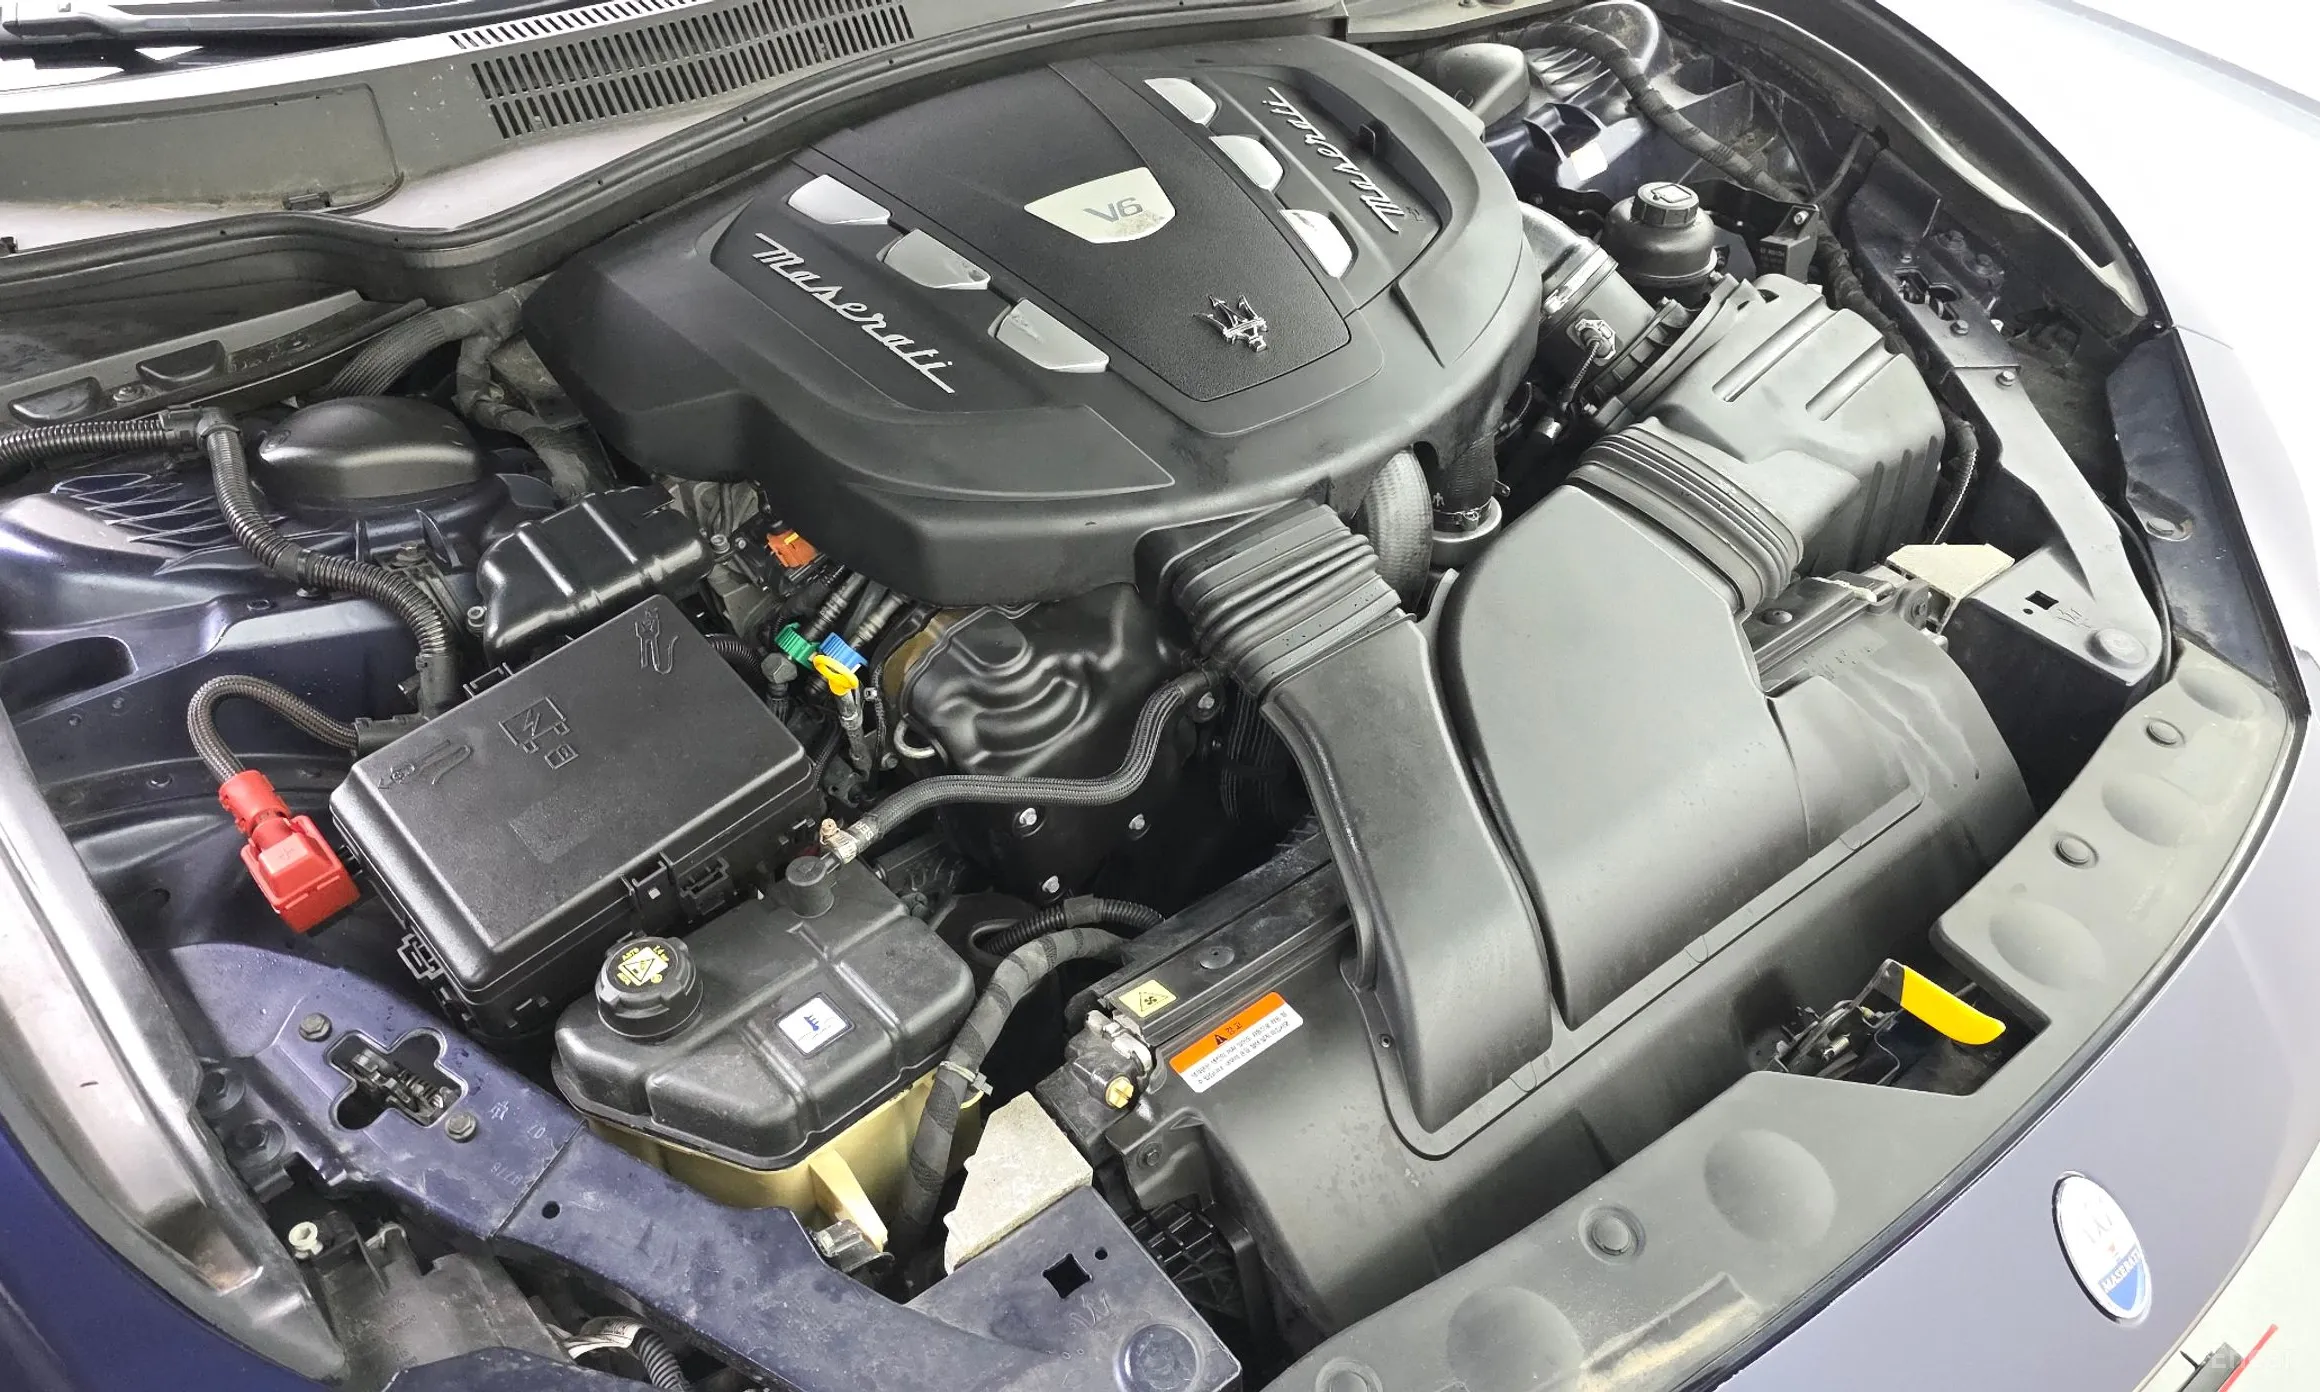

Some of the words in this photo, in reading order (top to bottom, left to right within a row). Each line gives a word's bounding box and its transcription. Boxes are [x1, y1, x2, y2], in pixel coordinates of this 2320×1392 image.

[1082, 196, 1144, 224] V6
[1262, 87, 1403, 232] Maserati
[753, 234, 955, 393] Maserati
